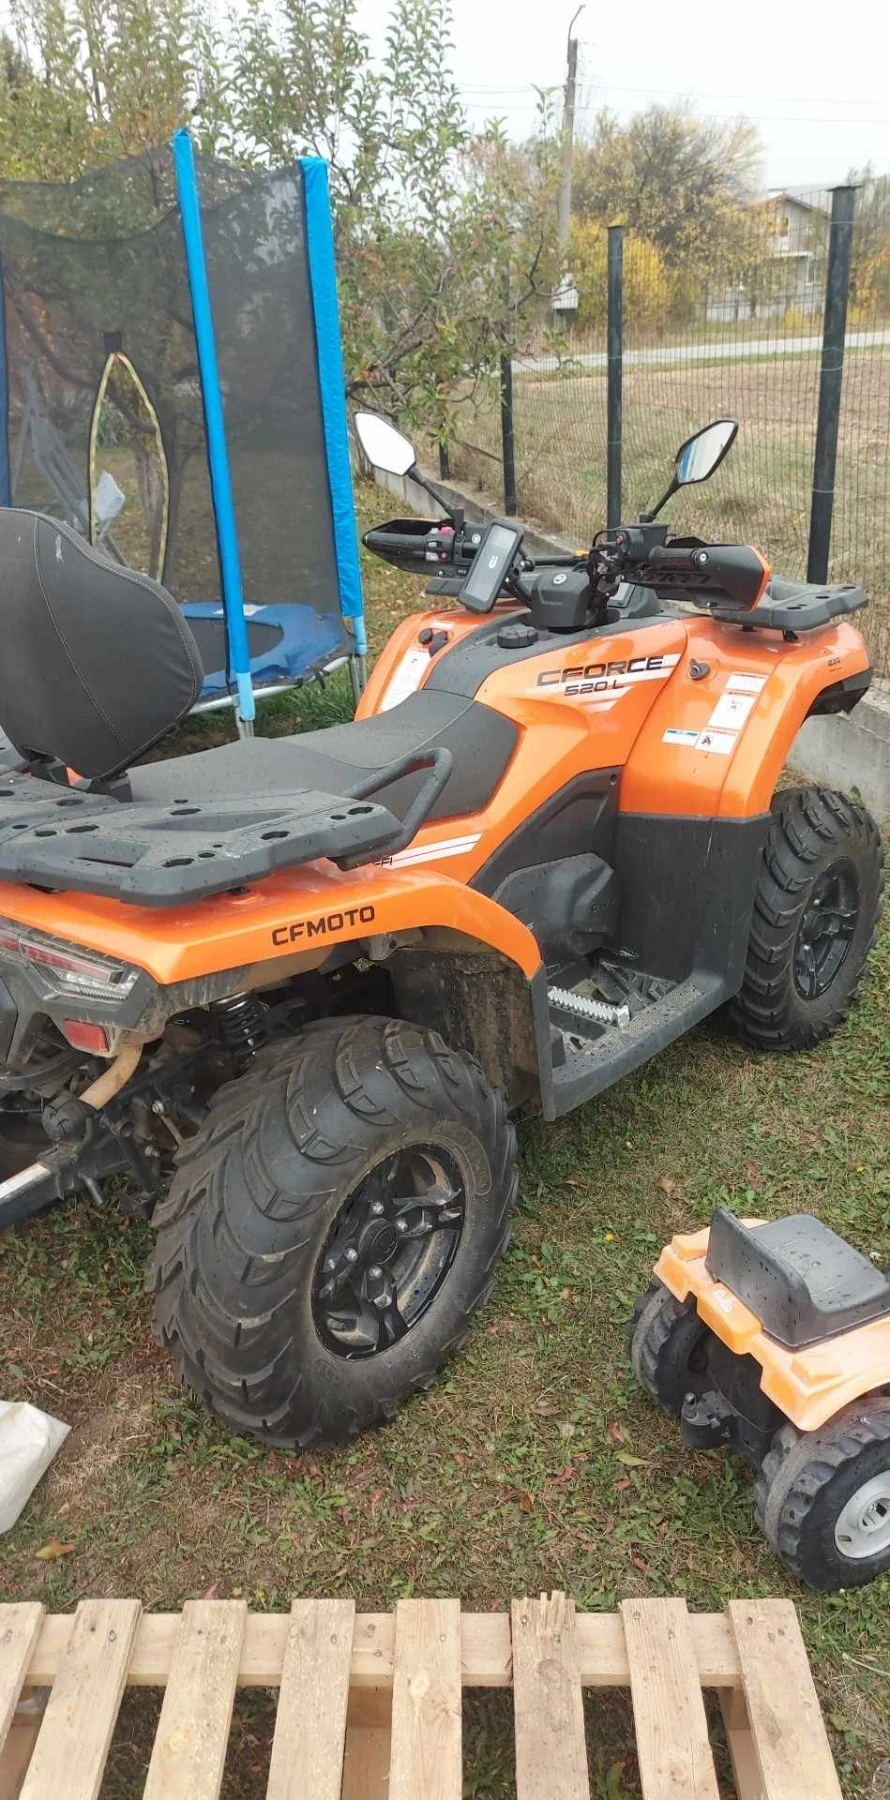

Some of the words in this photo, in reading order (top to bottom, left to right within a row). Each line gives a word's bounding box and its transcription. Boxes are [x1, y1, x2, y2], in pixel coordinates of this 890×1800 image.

[537, 655, 664, 687] CFORCE
[564, 681, 609, 697] 520
[612, 679, 625, 690] L
[271, 905, 375, 946] CFMOTO
